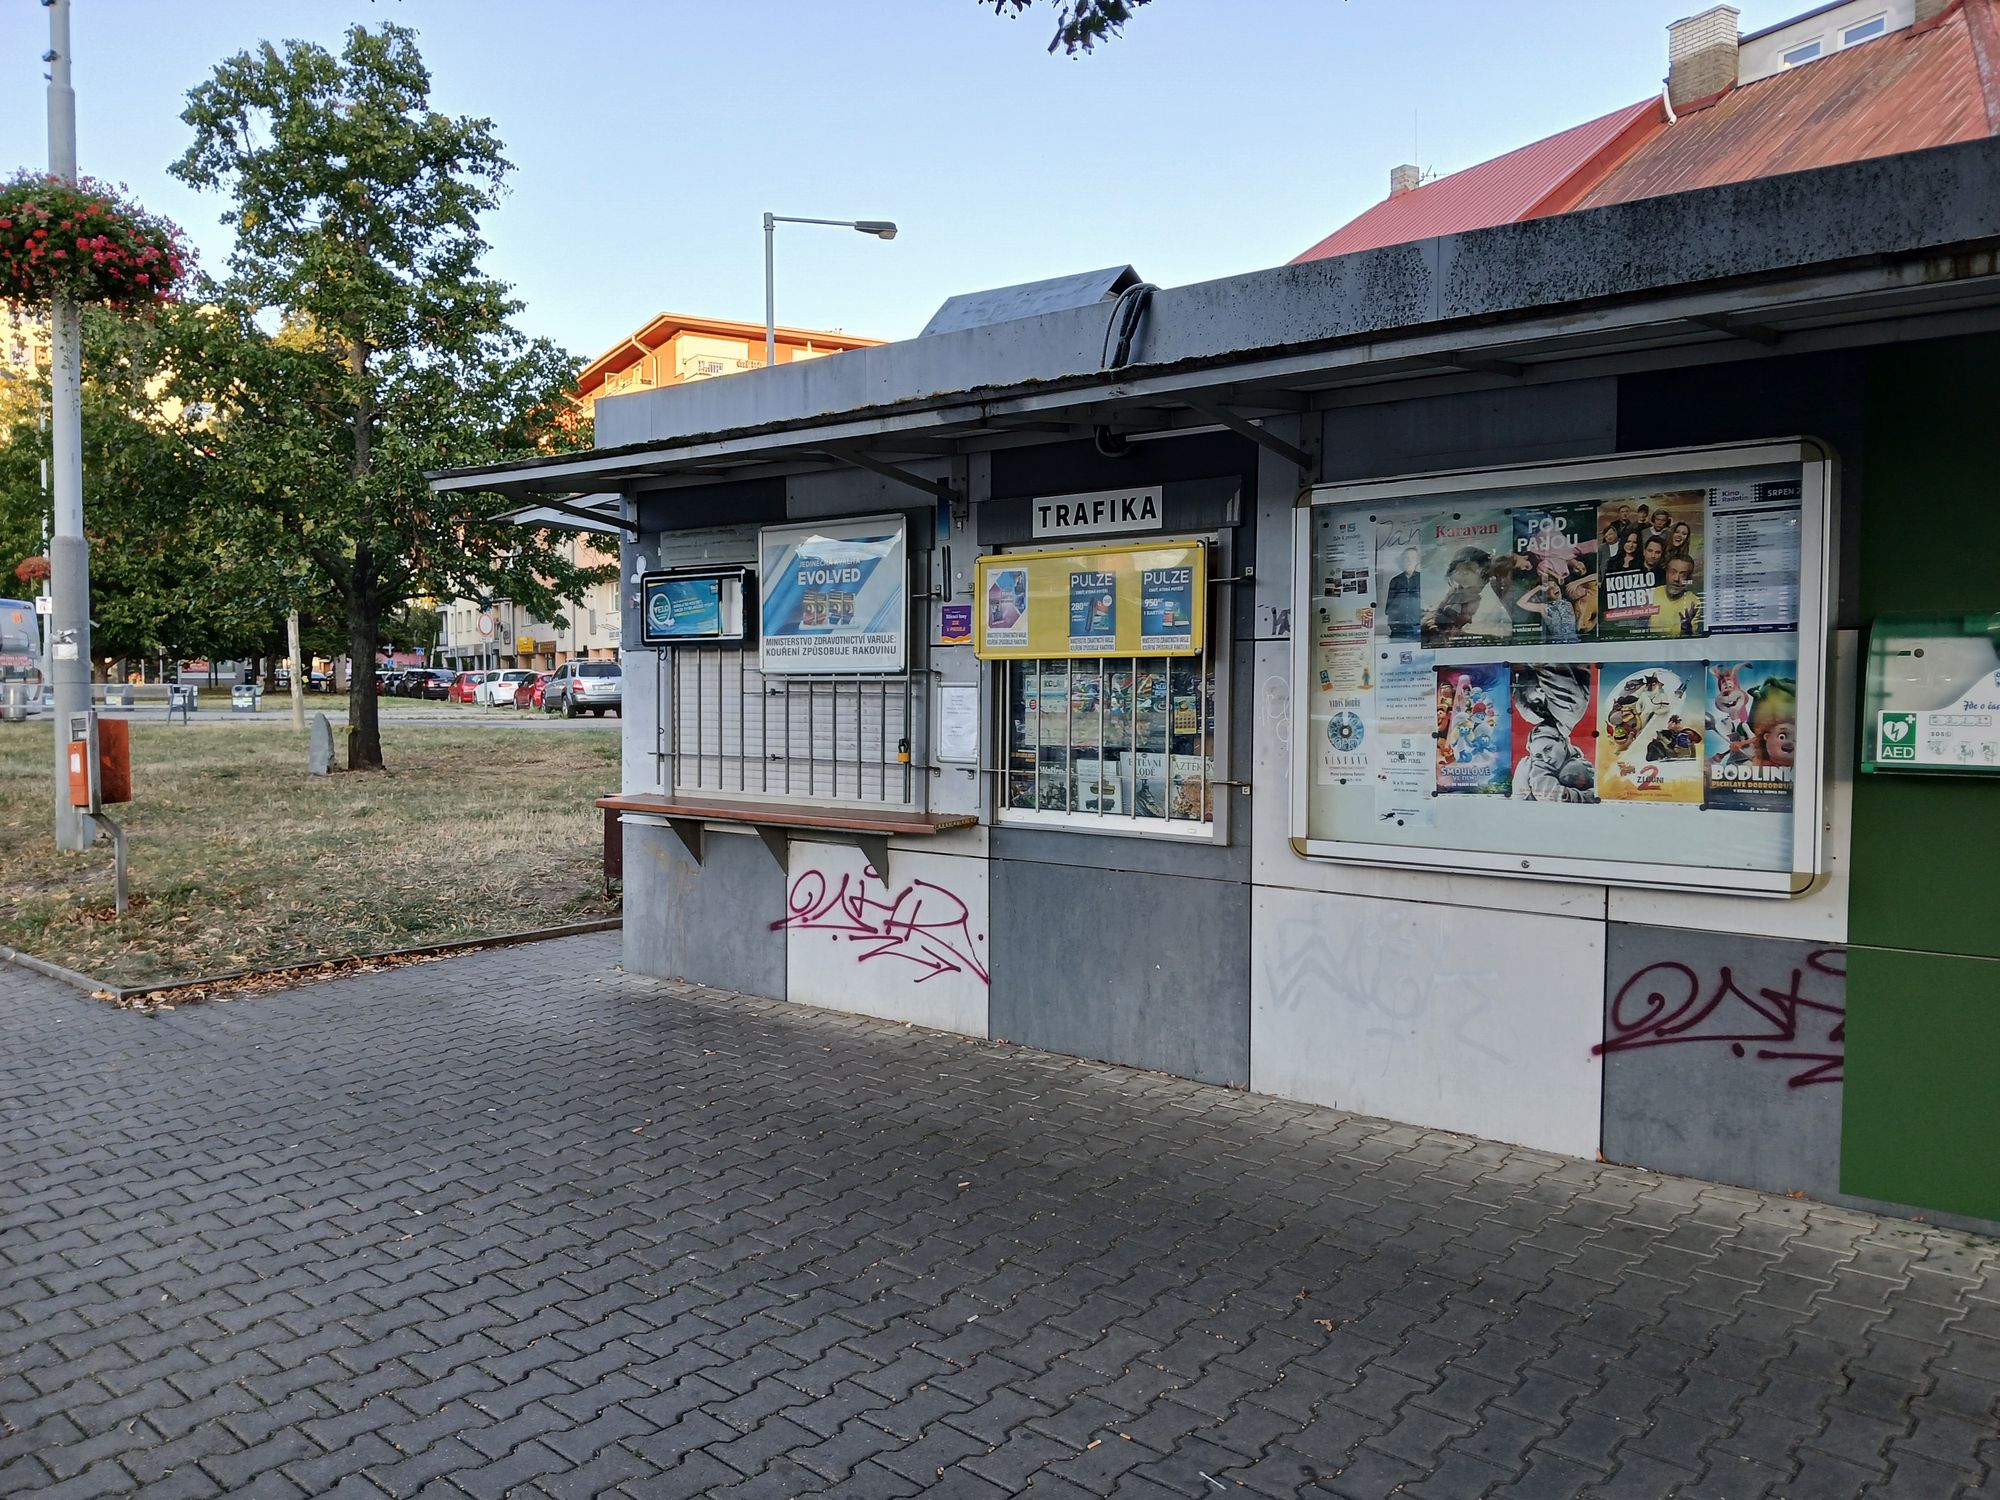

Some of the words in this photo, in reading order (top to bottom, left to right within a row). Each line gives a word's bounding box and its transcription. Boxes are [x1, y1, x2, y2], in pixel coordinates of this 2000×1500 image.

[1767, 489, 1795, 497] SRPEN
[1038, 496, 1157, 529] TRAFIKA
[1435, 523, 1498, 539] Karavan
[1528, 516, 1567, 534] POD
[797, 568, 861, 586] EVOLVED
[1071, 573, 1113, 588] PULZE
[1143, 570, 1190, 585] PULZE
[1605, 571, 1656, 592] KOUZLO
[1144, 599, 1158, 607] 950
[1606, 587, 1656, 610] DERBY
[766, 635, 813, 646] MINISTERSTVO
[813, 633, 865, 645] ZDRAVOTNICTVÍ
[867, 634, 897, 644] VARUJE:
[766, 646, 800, 657] KOUŘENÍ
[802, 645, 850, 656] ZPŮSOBUJE
[852, 645, 897, 655] RAKOVINU
[1882, 746, 1914, 759] AED
[1637, 764, 1662, 791] 2
